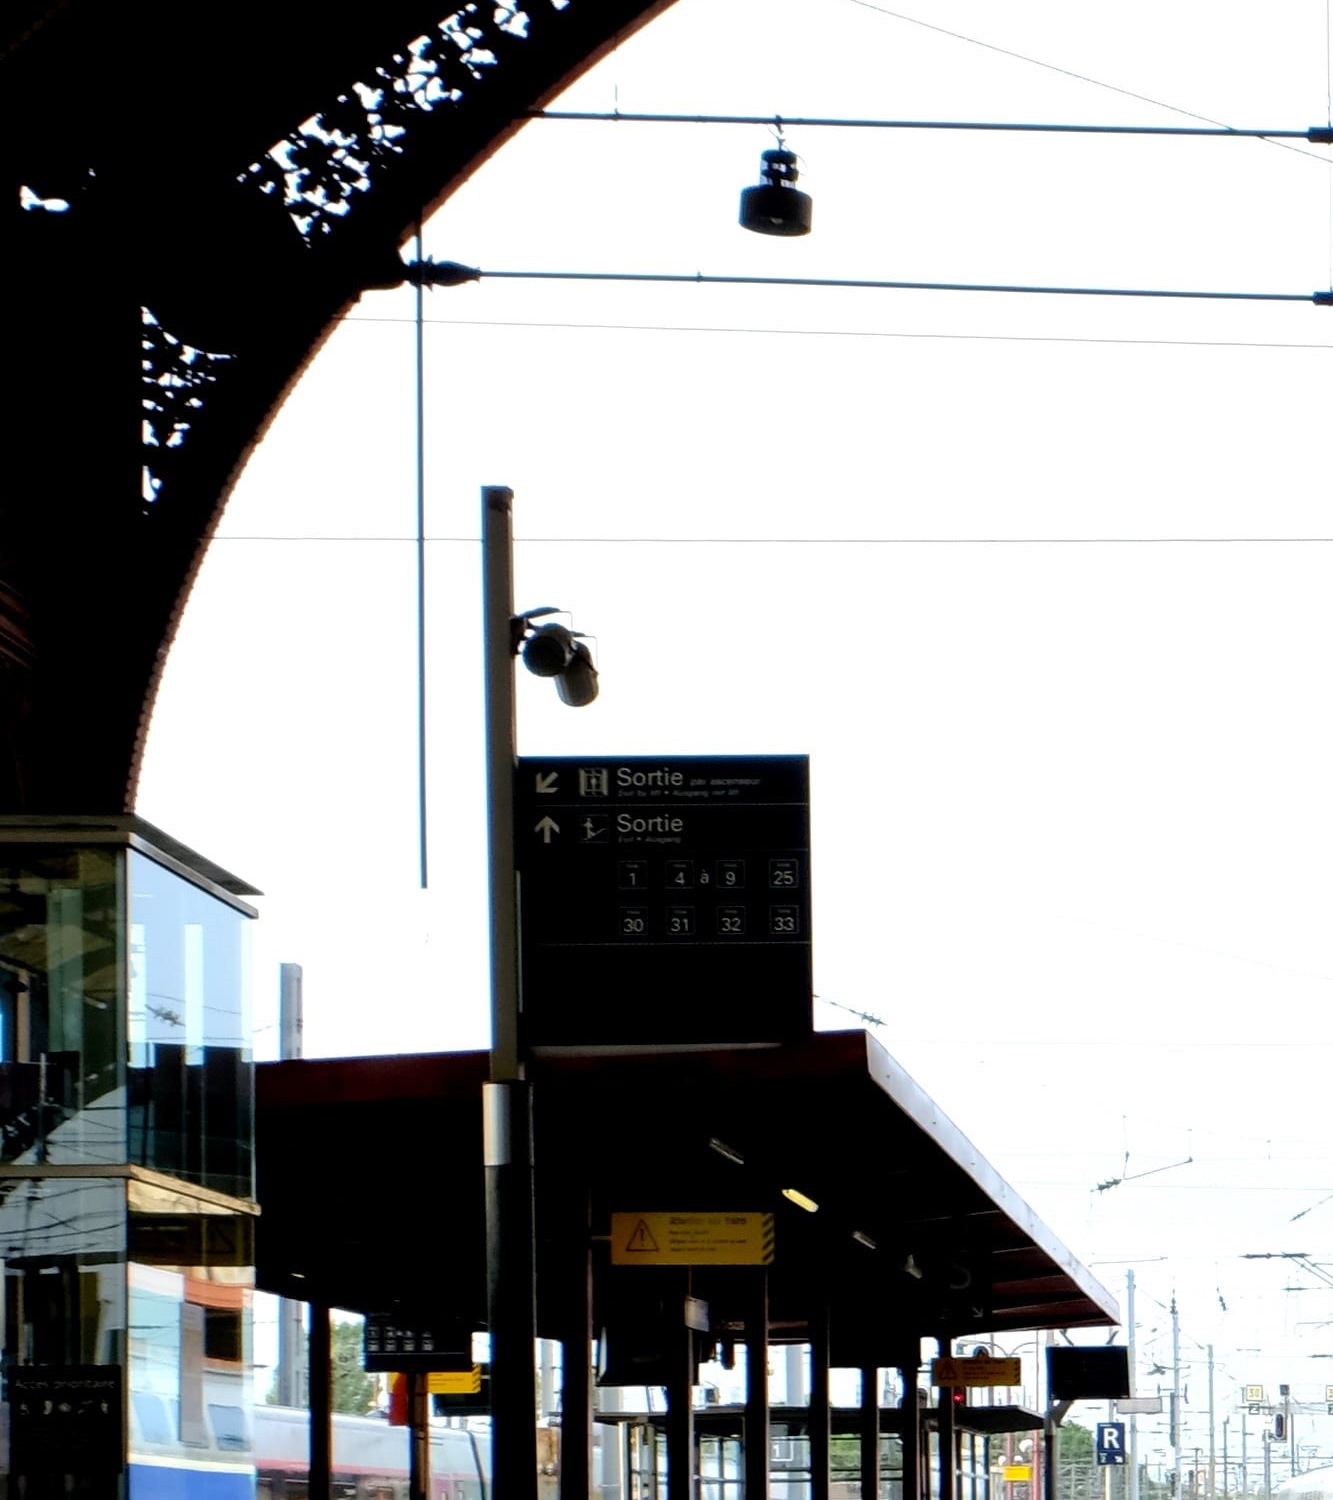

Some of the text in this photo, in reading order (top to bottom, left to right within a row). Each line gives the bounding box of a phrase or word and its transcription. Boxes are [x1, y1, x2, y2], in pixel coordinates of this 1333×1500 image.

[616, 766, 684, 787] Sortie
[616, 813, 684, 833] Sortie
[628, 868, 795, 887] 1 4 à 9 25
[623, 916, 796, 932] 30 31 32 33
[1103, 1427, 1121, 1449] R
